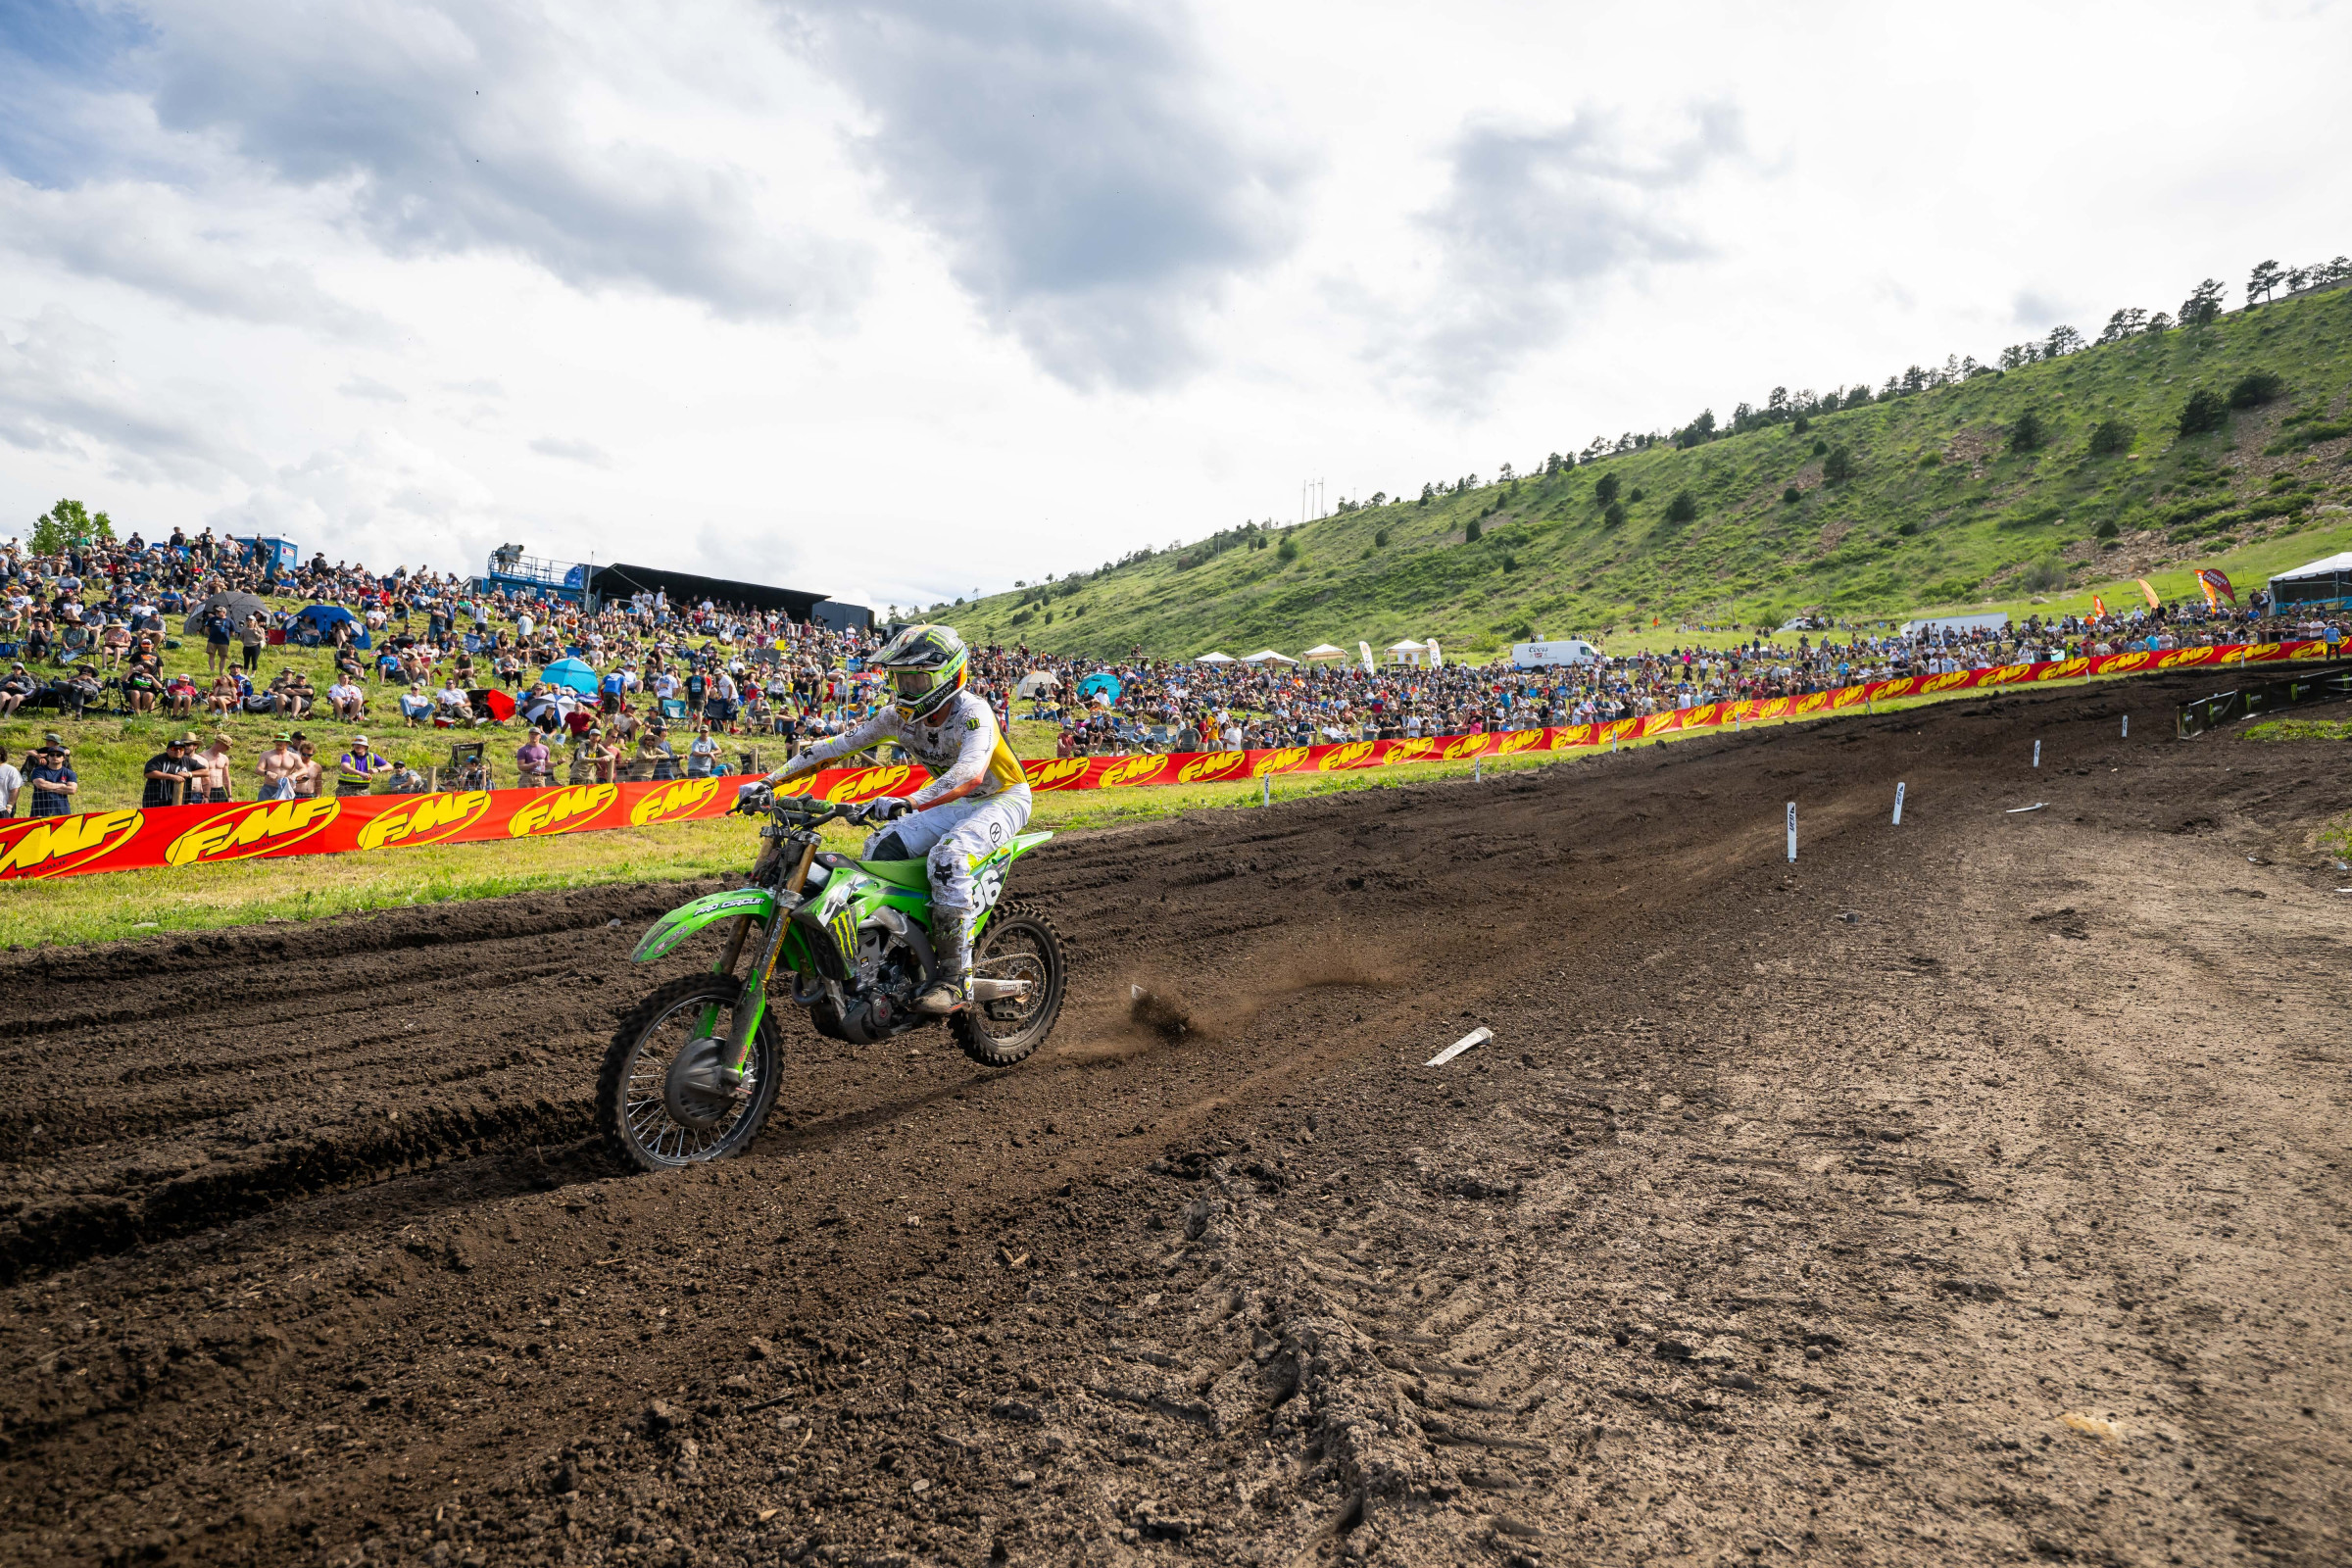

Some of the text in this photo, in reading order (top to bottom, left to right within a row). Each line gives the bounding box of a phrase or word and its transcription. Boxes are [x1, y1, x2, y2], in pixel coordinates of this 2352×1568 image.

[2098, 651, 2149, 674] FMF
[2159, 646, 2213, 668] FMF
[2222, 642, 2279, 663] FMF
[1978, 663, 2029, 686] FMF
[2038, 657, 2088, 680] FMF
[925, 682, 955, 706] MONSTER
[1871, 677, 1912, 702] FMF
[1921, 670, 1968, 694] FMF
[1760, 697, 1788, 719] FMF
[1796, 691, 1826, 713] FMF
[1835, 684, 1863, 709] FMF
[1643, 711, 1674, 737] FMF
[1684, 704, 1715, 730] FMF
[1722, 700, 1752, 724] FMF
[1500, 728, 1542, 755] FMF
[1551, 724, 1589, 750] FMF
[1600, 717, 1635, 744] FMF
[1321, 741, 1372, 772] FMF
[1384, 737, 1433, 764] FMF
[1445, 733, 1489, 760] FMF
[1026, 757, 1088, 789] FMF
[1102, 754, 1166, 789] FMF
[1181, 750, 1244, 783] FMF
[1255, 746, 1308, 778] FMF
[832, 765, 908, 804] FMF
[513, 782, 615, 839] FMF
[633, 777, 717, 826] FMF
[172, 797, 337, 866] FMF
[363, 791, 487, 851] FMF
[0, 808, 138, 875] MF
[694, 897, 764, 917] PRO CIRCUIT
